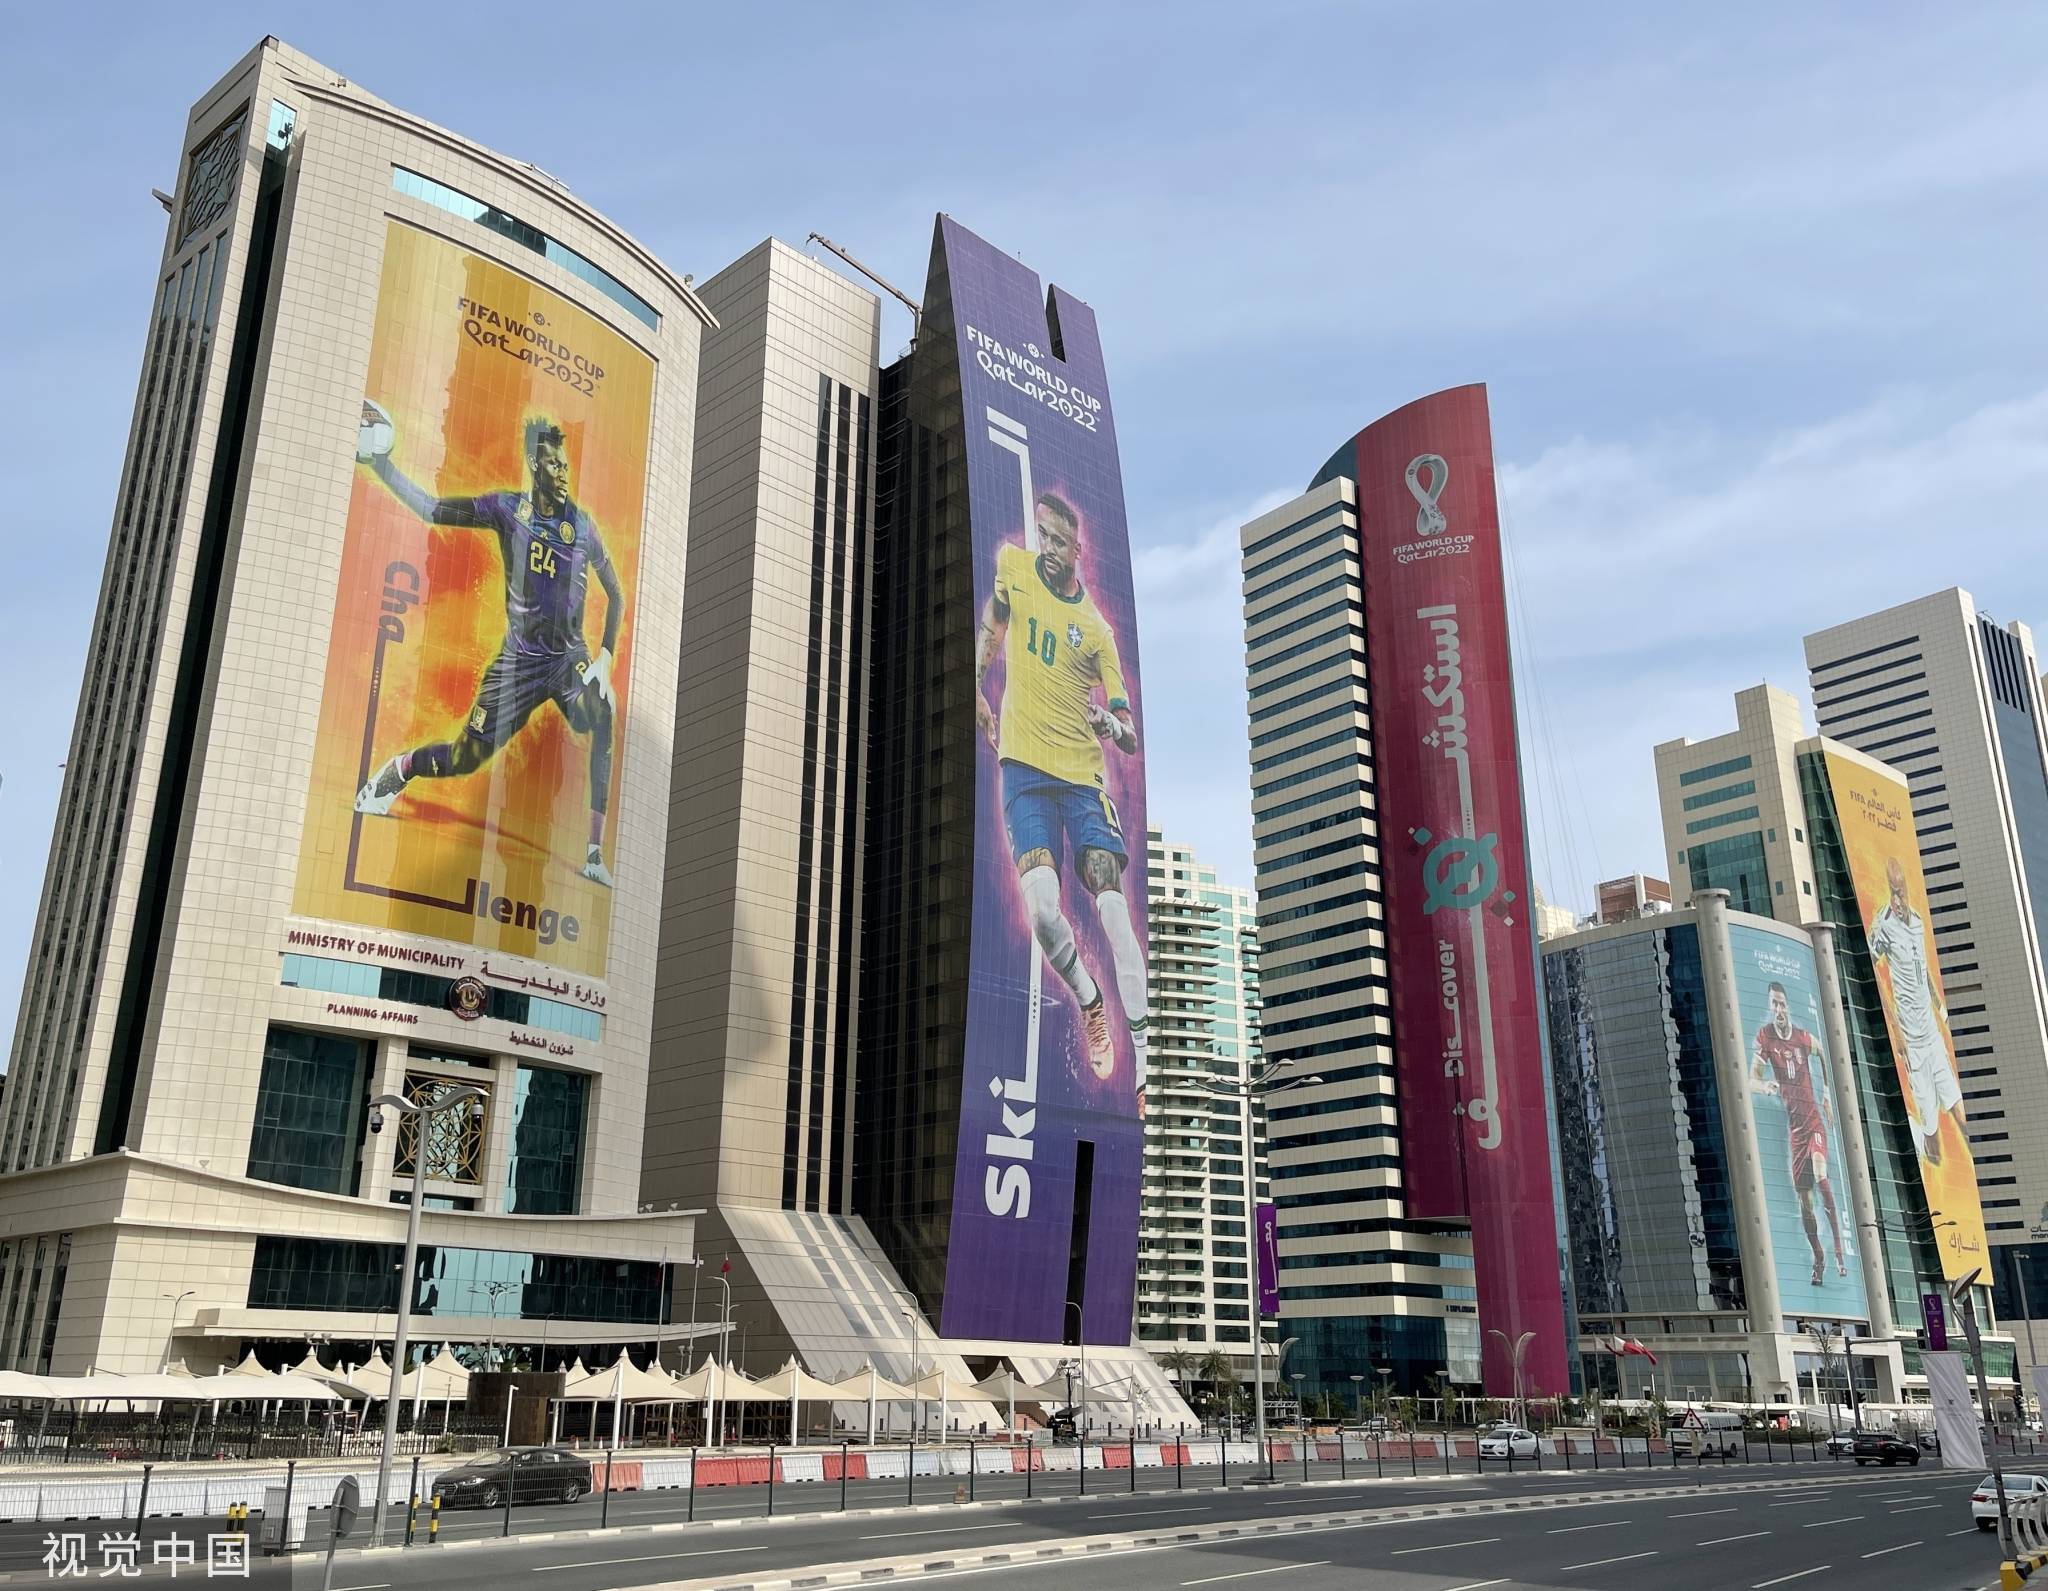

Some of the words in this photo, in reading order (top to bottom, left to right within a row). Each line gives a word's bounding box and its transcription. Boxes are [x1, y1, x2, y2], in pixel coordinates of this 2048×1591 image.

[458, 296, 501, 327] FIFA
[504, 316, 571, 361] WORLD
[573, 354, 605, 380] CUP
[966, 324, 1006, 360] FIFA
[1006, 347, 1069, 395] WORLD
[1070, 386, 1102, 414] CUP
[530, 541, 556, 578] 24
[1392, 543, 1415, 556] FIFA
[1414, 536, 1453, 550] WORLD
[1454, 534, 1475, 544] CUP
[1027, 616, 1057, 667] 10
[288, 930, 356, 951] MINISTRY
[357, 941, 376, 955] OF
[377, 944, 465, 970] MUNICIPALITY
[327, 1003, 378, 1020] PLANNING
[380, 1010, 419, 1025] AFFAIRS
[574, 984, 606, 1007] وزارة
[509, 1031, 547, 1049] التخطيط
